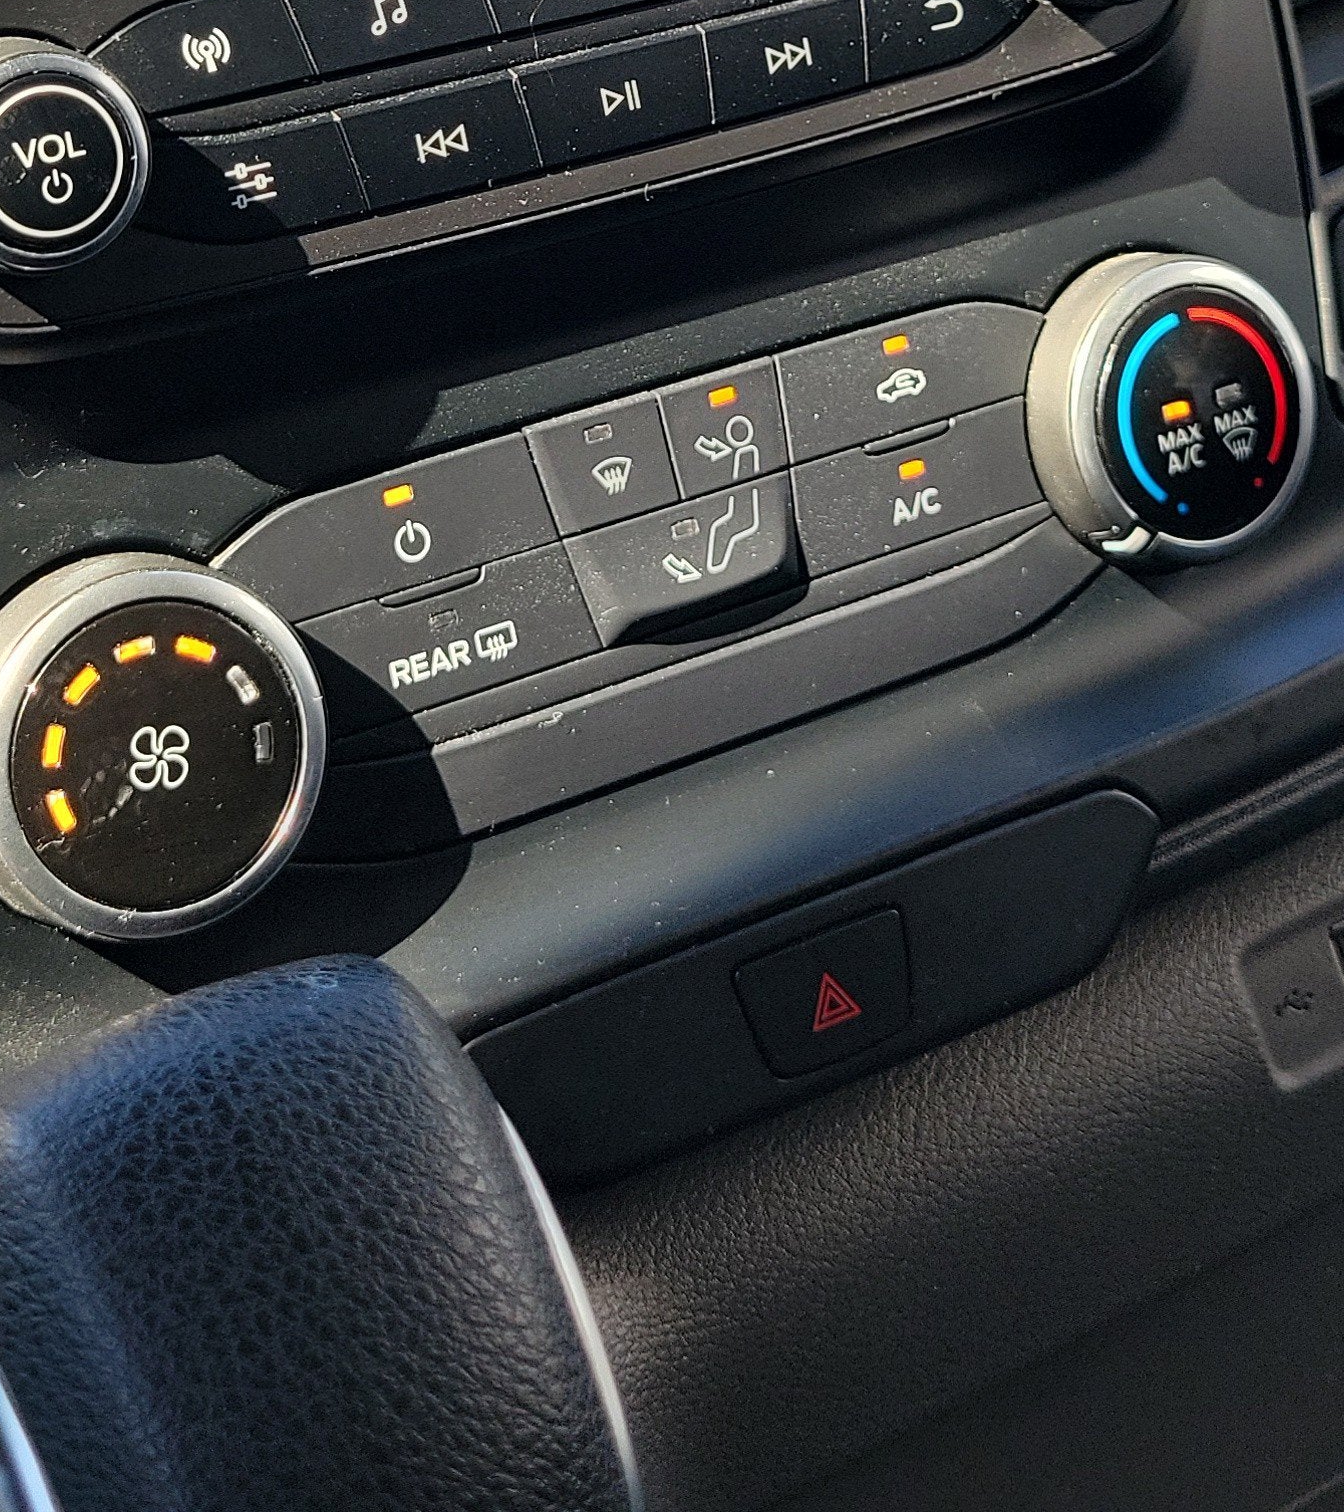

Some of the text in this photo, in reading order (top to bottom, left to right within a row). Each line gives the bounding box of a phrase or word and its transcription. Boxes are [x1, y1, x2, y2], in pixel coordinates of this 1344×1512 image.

[11, 131, 86, 169] VOL
[1157, 422, 1206, 453] MAX
[1213, 404, 1259, 436] MAX
[1167, 443, 1206, 477] A/C
[892, 487, 942, 527] A/C
[388, 639, 472, 690] REAR
